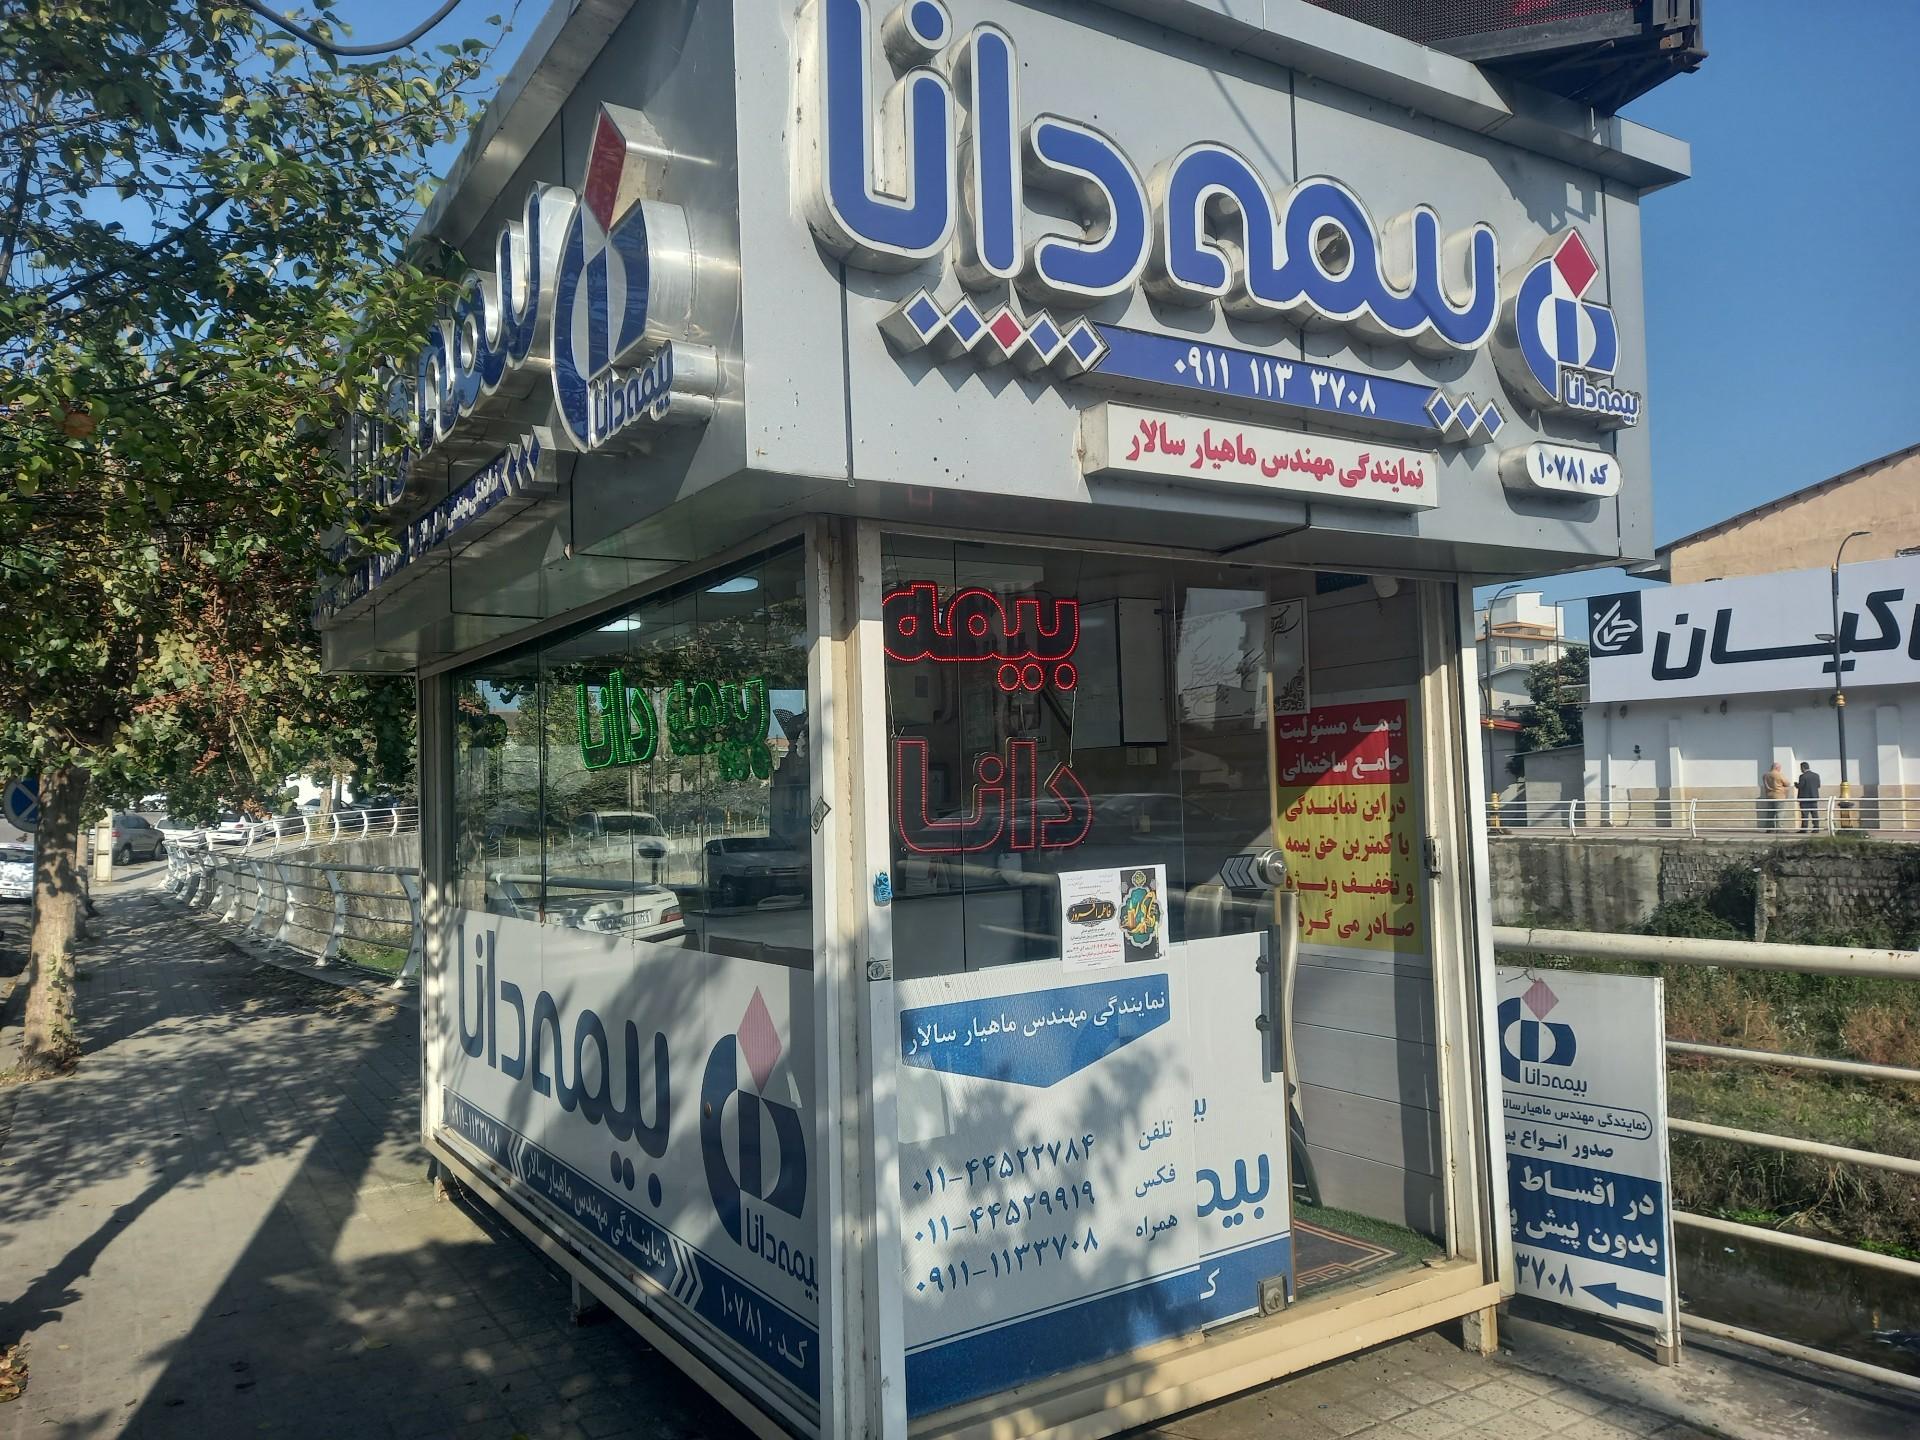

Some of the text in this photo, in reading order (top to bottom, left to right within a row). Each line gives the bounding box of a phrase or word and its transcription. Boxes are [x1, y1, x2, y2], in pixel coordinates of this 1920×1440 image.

[822, 0, 1151, 296] دانا
[1174, 347, 1376, 414] ۰۹۱۱ ۱۱۳ ۳۷۰۸
[1566, 373, 1639, 423] بیمه دانا
[1126, 419, 1424, 492] نمایندگی مهندس ماهیار سالار
[1539, 452, 1608, 484] کد ۱۰۷۸۱
[882, 583, 1080, 692] بیمه
[1652, 588, 1905, 681] کیان
[576, 667, 773, 781] بیمه دانا
[1280, 714, 1402, 743] بیمه مسئولیت
[1283, 748, 1404, 782] جامع ساختمانی
[896, 736, 1093, 853] دانا
[1285, 792, 1406, 822] در این نمایندگی
[1285, 832, 1409, 862] با کمترین حق بیمه
[1285, 871, 1413, 904] و تخفیف ویژه
[1338, 919, 1360, 938] می
[1365, 912, 1415, 941] صادر
[909, 990, 1165, 1055] نمایندگی مهندس ماهیار سالار
[456, 923, 670, 1209] بیمه دانا
[1525, 1067, 1588, 1097] بیمه دانا
[1521, 1102, 1551, 1116] ماهیار
[1555, 1109, 1594, 1126] مهندس
[1598, 1112, 1647, 1133] نمایندگی
[912, 1119, 1173, 1195] تلفن ۰۱۱-۴۴۵۲۲۷۸۴
[1520, 1129, 1567, 1151] انواع
[1571, 1143, 1614, 1159] صدور
[527, 1152, 666, 1267] نمایندگی مهندس ماهیار سالار
[914, 1162, 1176, 1244] فکس ۰۱۱-۴۴۵۲۹۹۱۹
[1520, 1165, 1654, 1221] در اقساط
[746, 1207, 776, 1264] دانا
[916, 1213, 1178, 1293] همراه ۰۹۱۱-۱۱۳۳۷۰۸
[1525, 1209, 1580, 1249] پیش
[1587, 1228, 1658, 1264] بدون
[721, 1284, 762, 1343] ۱۰۷۸۱
